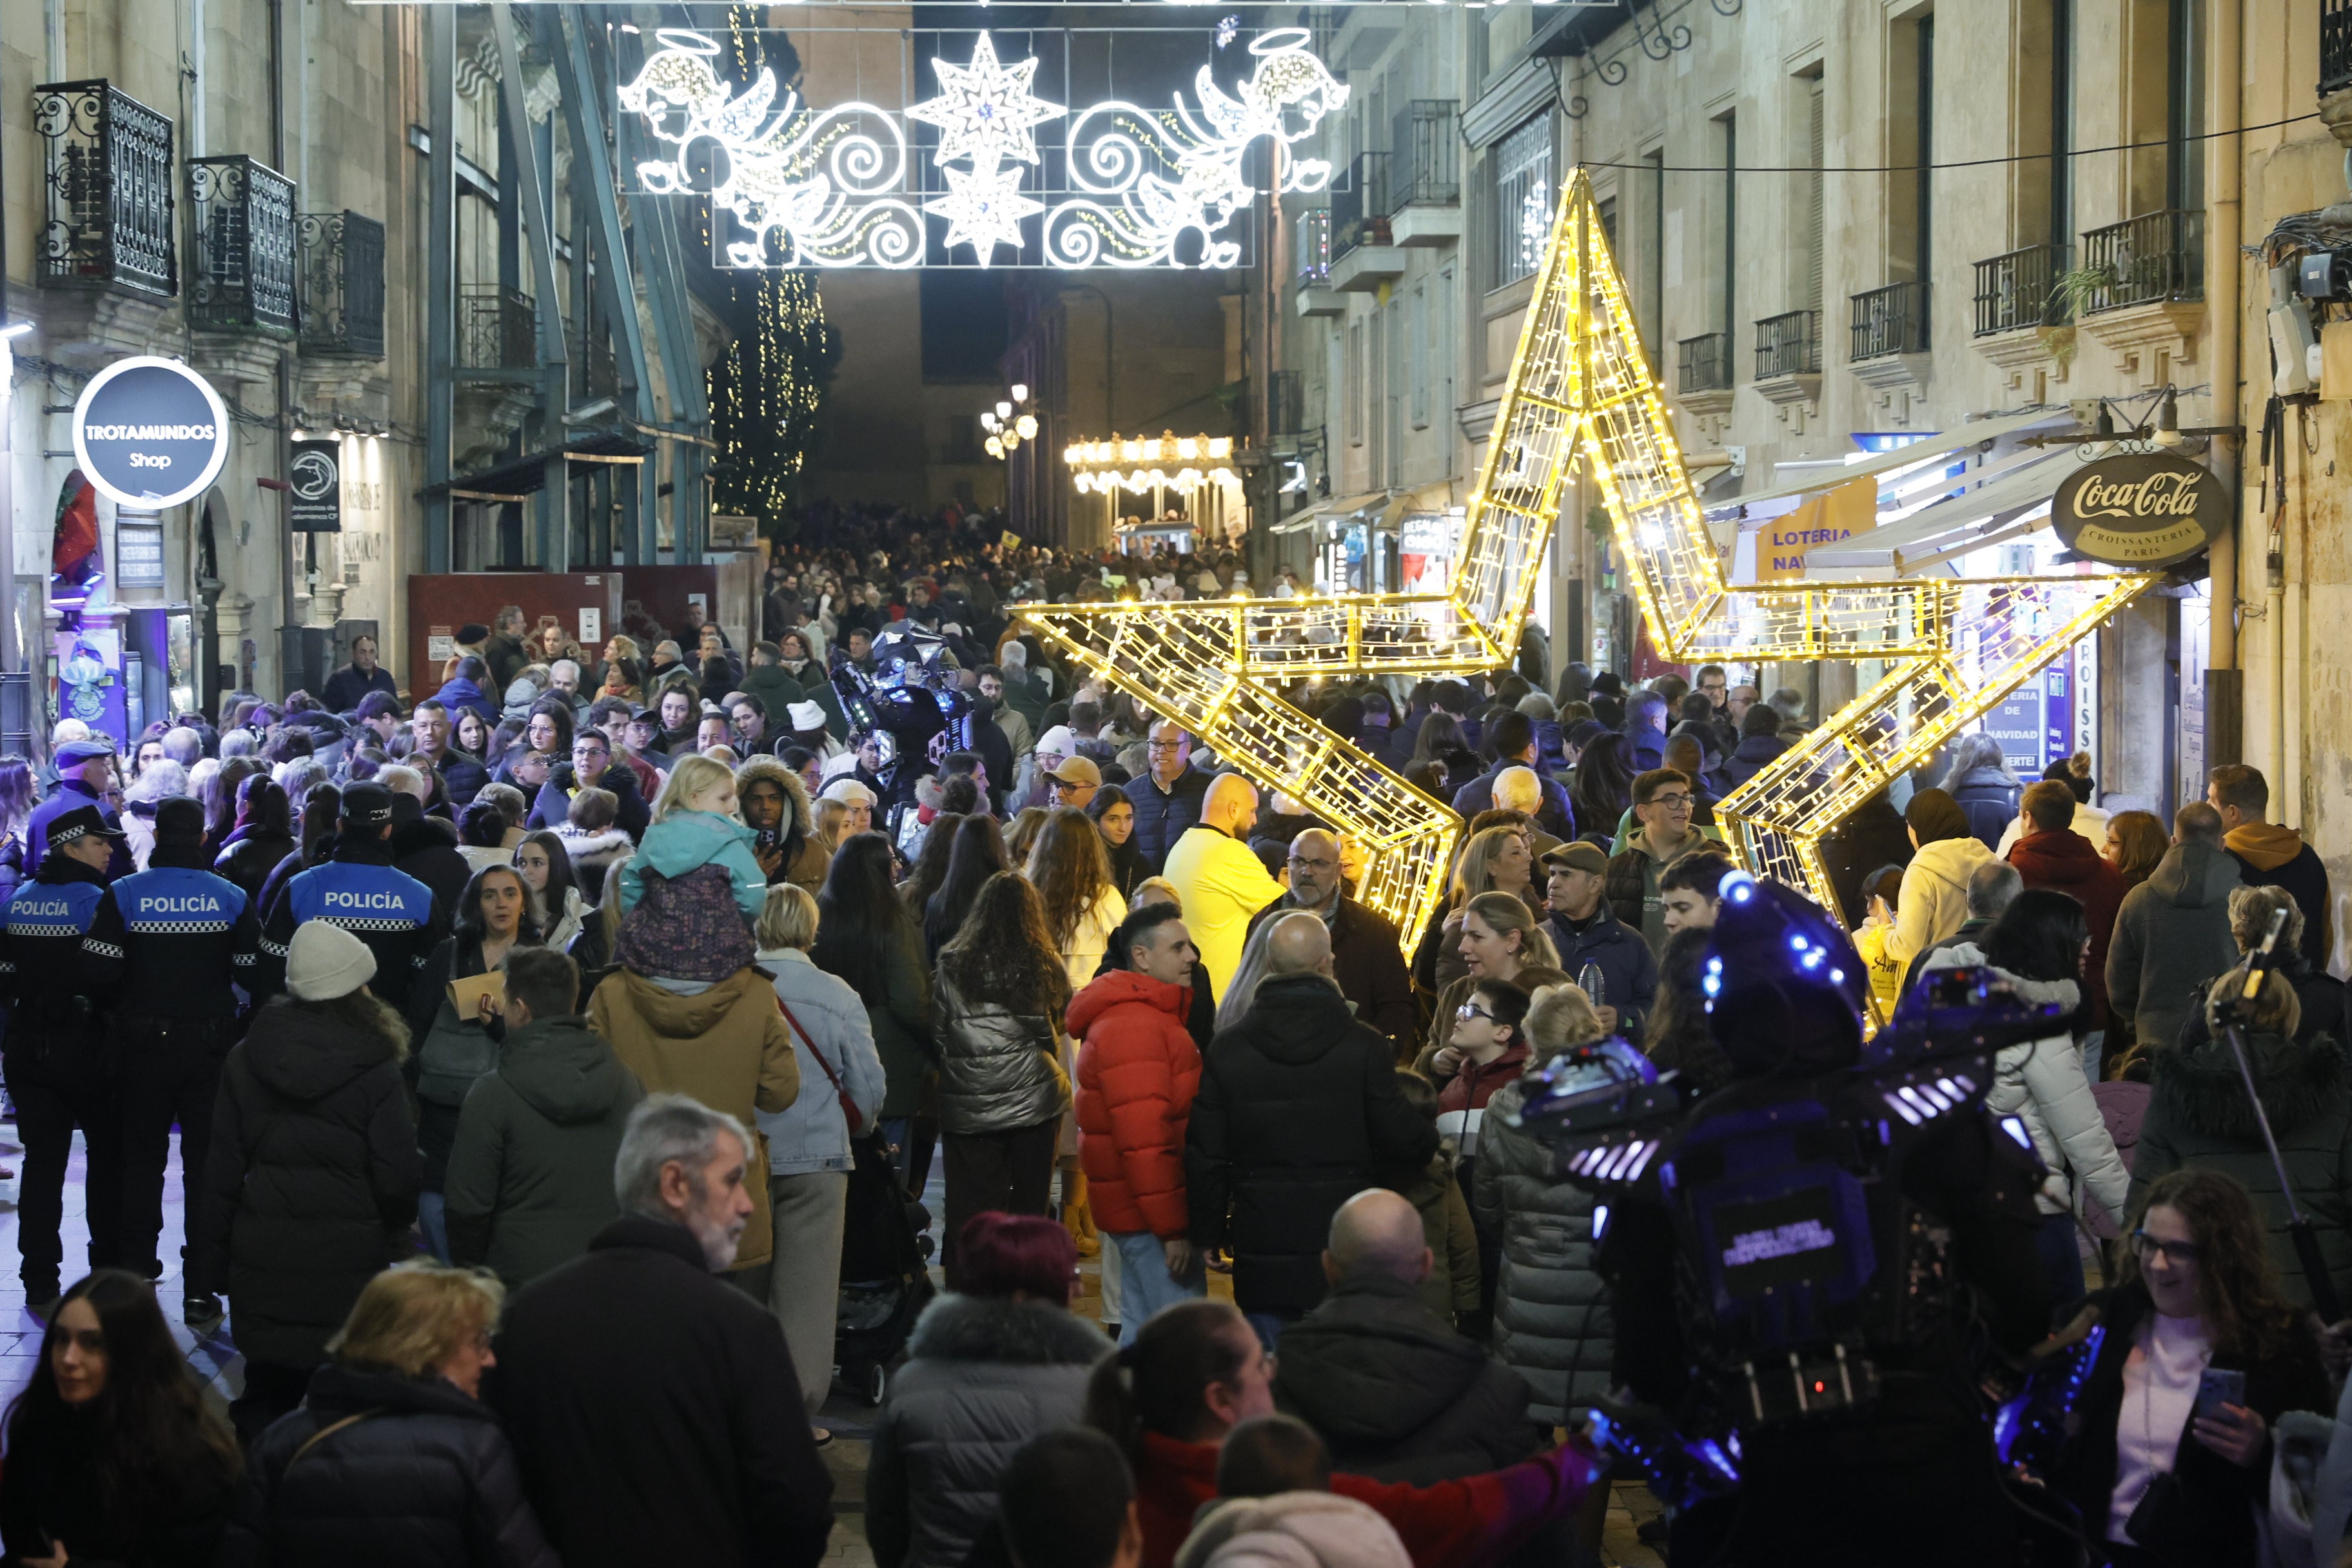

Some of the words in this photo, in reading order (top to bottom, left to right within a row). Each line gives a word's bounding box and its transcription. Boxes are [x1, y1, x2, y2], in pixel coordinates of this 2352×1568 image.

[85, 425, 215, 440] TROTAMUNDOS
[130, 453, 172, 469] Shop
[2073, 472, 2203, 518] Coca-Cola
[1773, 529, 1851, 545] LOTERIA
[2089, 529, 2192, 547] CROISSANTERIA
[2124, 548, 2160, 556] PARIS
[2080, 636, 2092, 747] ROISS
[2004, 707, 2021, 715] DE
[1988, 730, 2039, 740] NAVIDAD
[10, 899, 69, 916] POLICÍA
[140, 894, 220, 912] POLICÍA
[325, 891, 405, 910] POLICÍA
